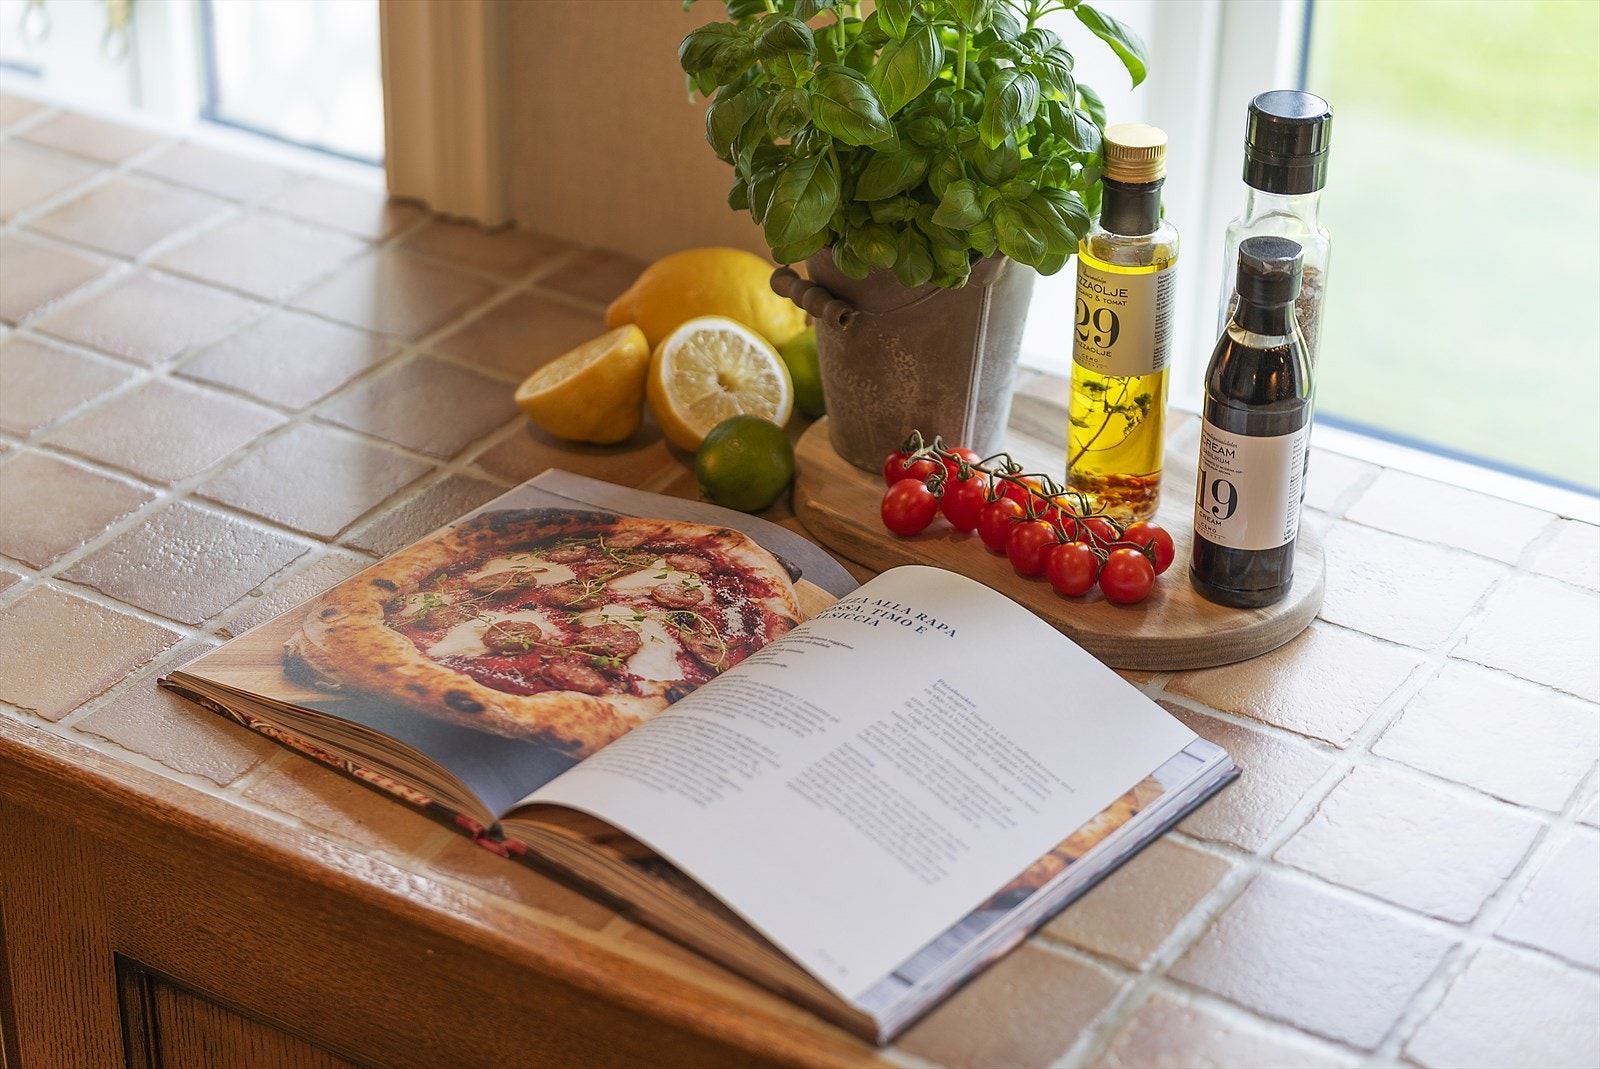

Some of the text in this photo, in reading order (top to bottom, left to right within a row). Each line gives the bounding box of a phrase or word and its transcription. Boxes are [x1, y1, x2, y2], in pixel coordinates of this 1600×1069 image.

[1078, 275, 1129, 298] ZZAOLJE
[1103, 297, 1128, 306] TOMAT
[1076, 297, 1120, 349] 29
[1197, 465, 1238, 520] 19
[1199, 510, 1222, 527] CREAM
[871, 599, 912, 615] ALLA
[915, 612, 957, 638] RAPA
[871, 607, 913, 627] TIMO
[915, 625, 928, 635] E
